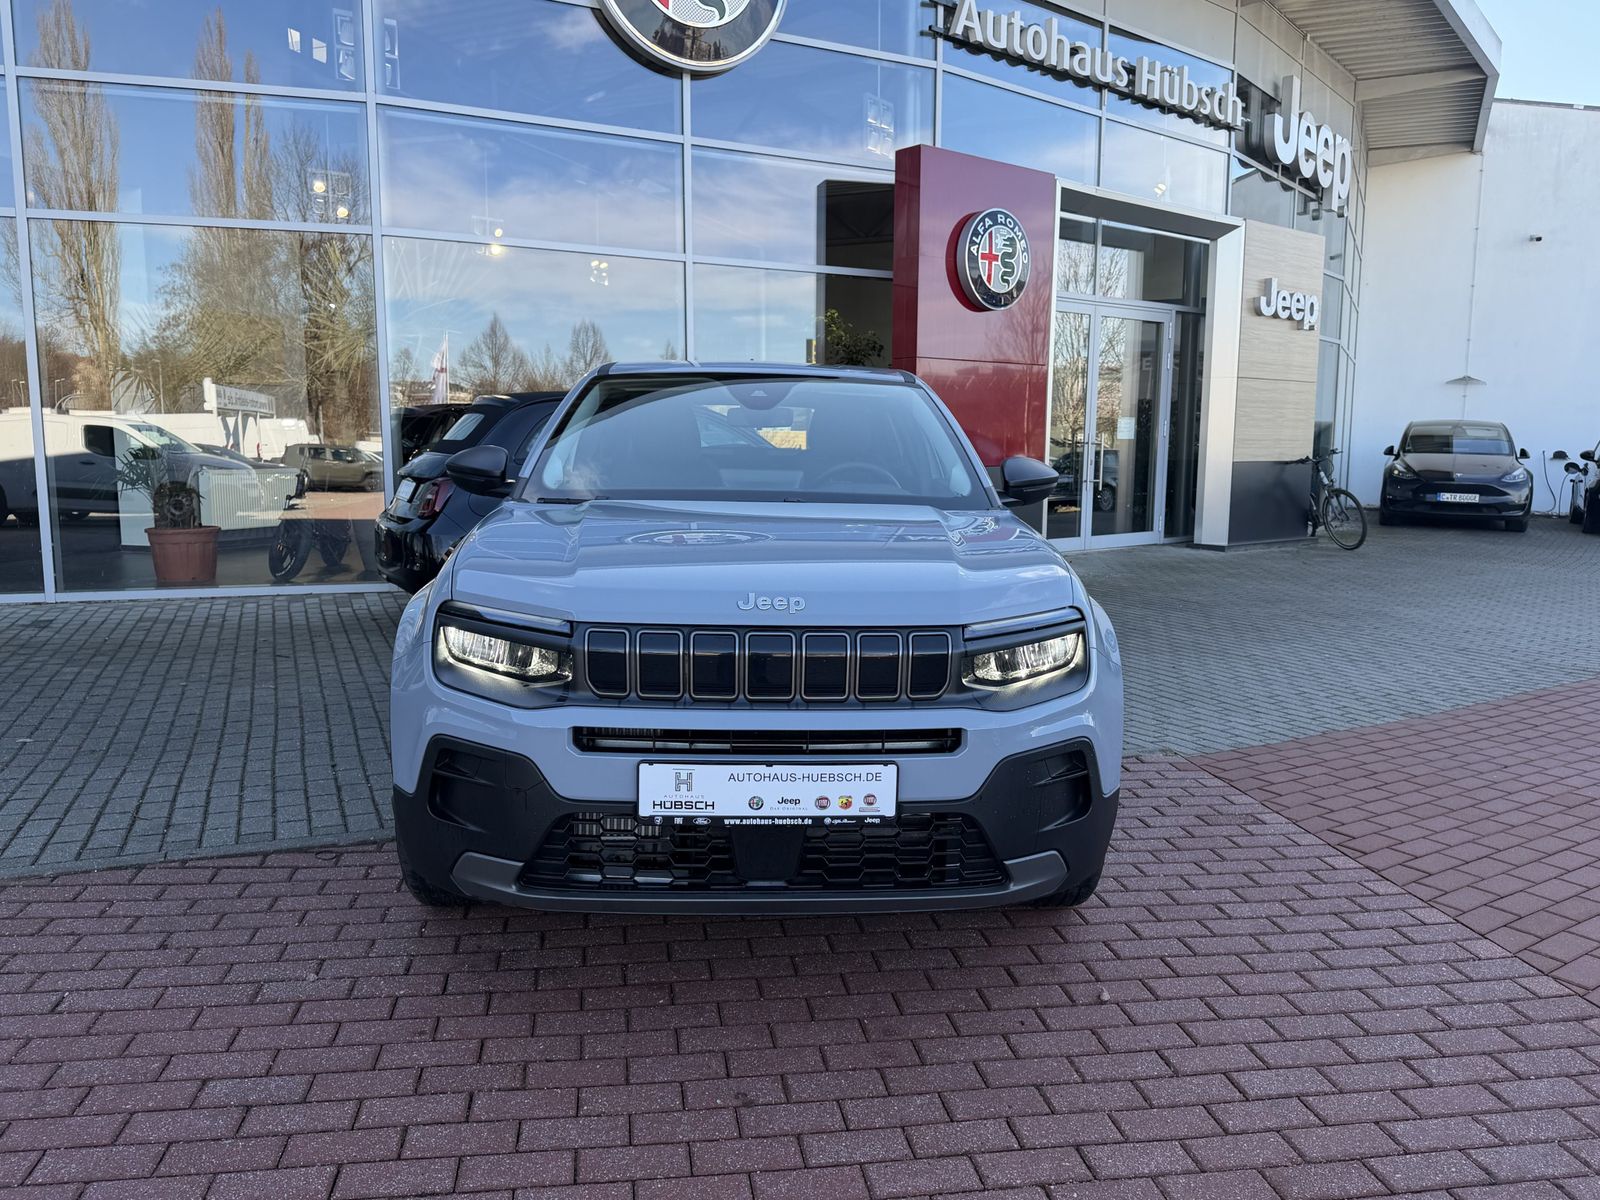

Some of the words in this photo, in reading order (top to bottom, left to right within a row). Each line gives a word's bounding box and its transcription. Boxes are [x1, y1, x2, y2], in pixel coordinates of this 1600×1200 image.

[950, 0, 1129, 87] Autohaus
[1136, 56, 1242, 127] Hübsch
[1266, 75, 1351, 211] Jeep
[970, 217, 993, 256] ALFA
[997, 214, 1028, 264] ROMEO
[1256, 277, 1319, 331] Jeep
[736, 592, 806, 614] Jeep
[728, 772, 882, 783] AUTOHAUS-HUEBSCH.DE
[652, 800, 715, 810] HÜBSCH
[777, 796, 801, 806] Jeep
